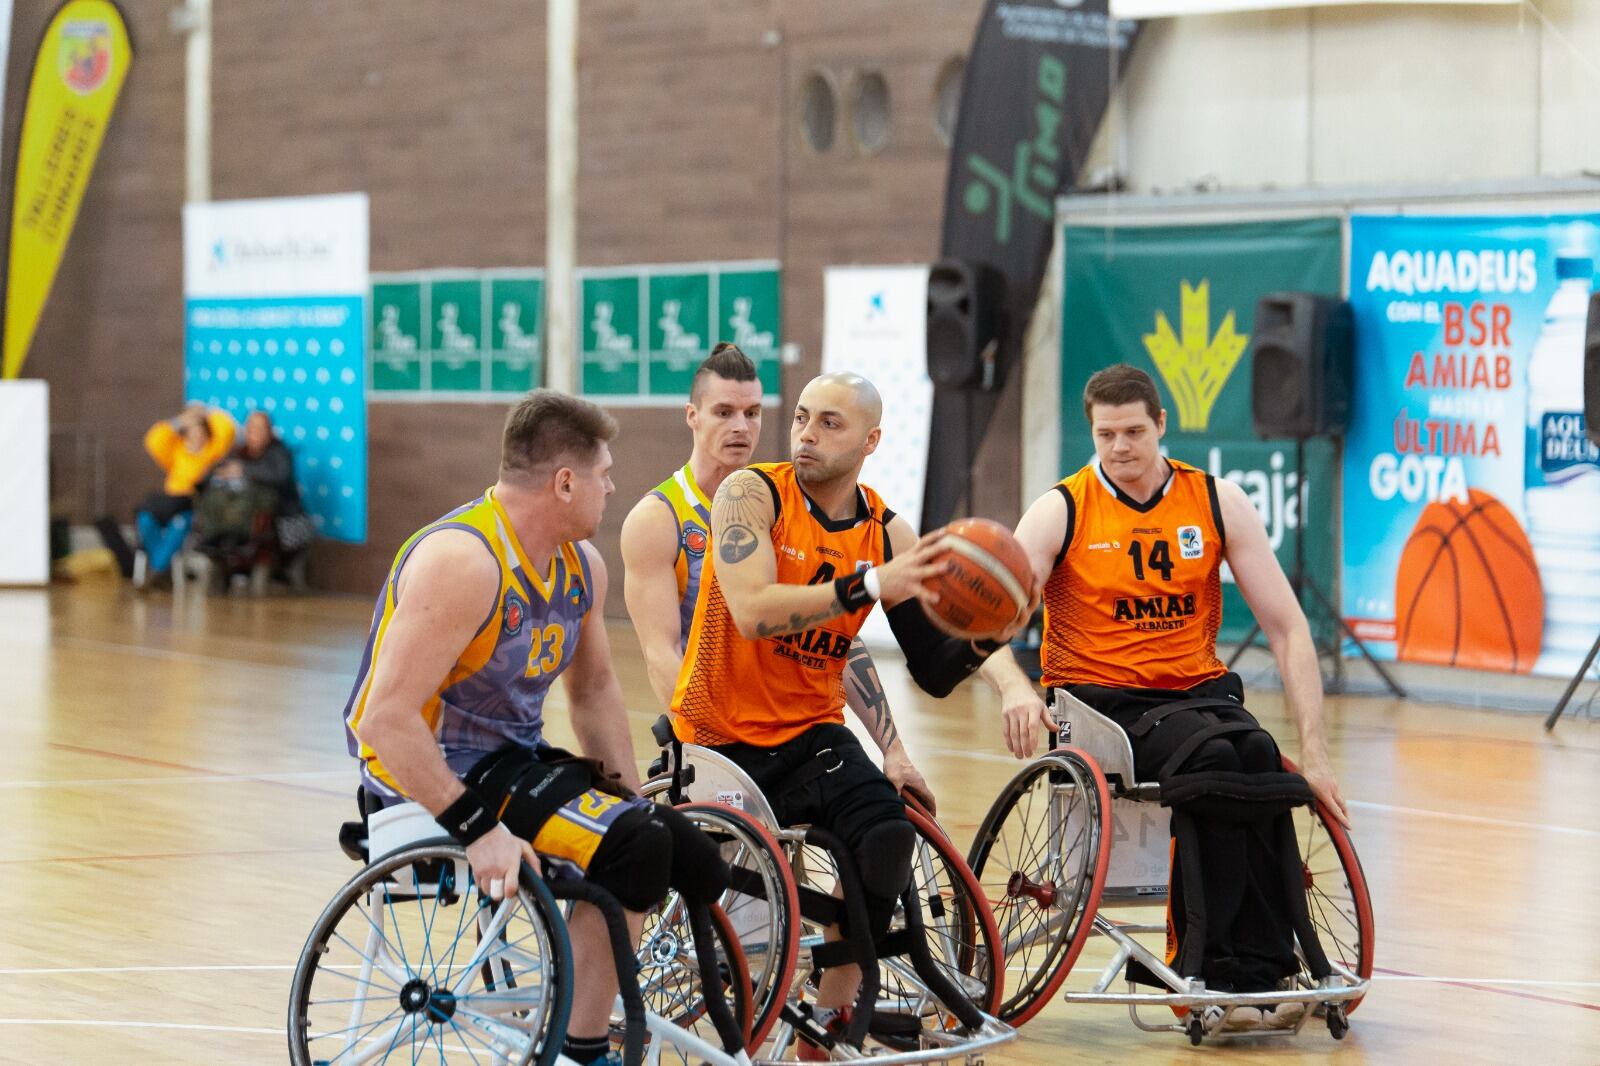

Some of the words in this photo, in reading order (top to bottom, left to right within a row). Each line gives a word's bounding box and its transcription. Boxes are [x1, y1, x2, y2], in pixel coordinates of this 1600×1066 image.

[1366, 249, 1537, 295] AQUADEUS
[1387, 301, 1422, 322] CON
[1424, 301, 1441, 323] EL
[1443, 303, 1512, 347] BSR
[1406, 352, 1513, 390] AMIAB
[1394, 407, 1502, 457] ÚLTIMA
[1369, 453, 1470, 504] GOTA
[1127, 539, 1175, 582] 14
[1114, 593, 1196, 621] AMIAB
[524, 623, 566, 678] 23
[774, 644, 828, 670] ALBCETE
